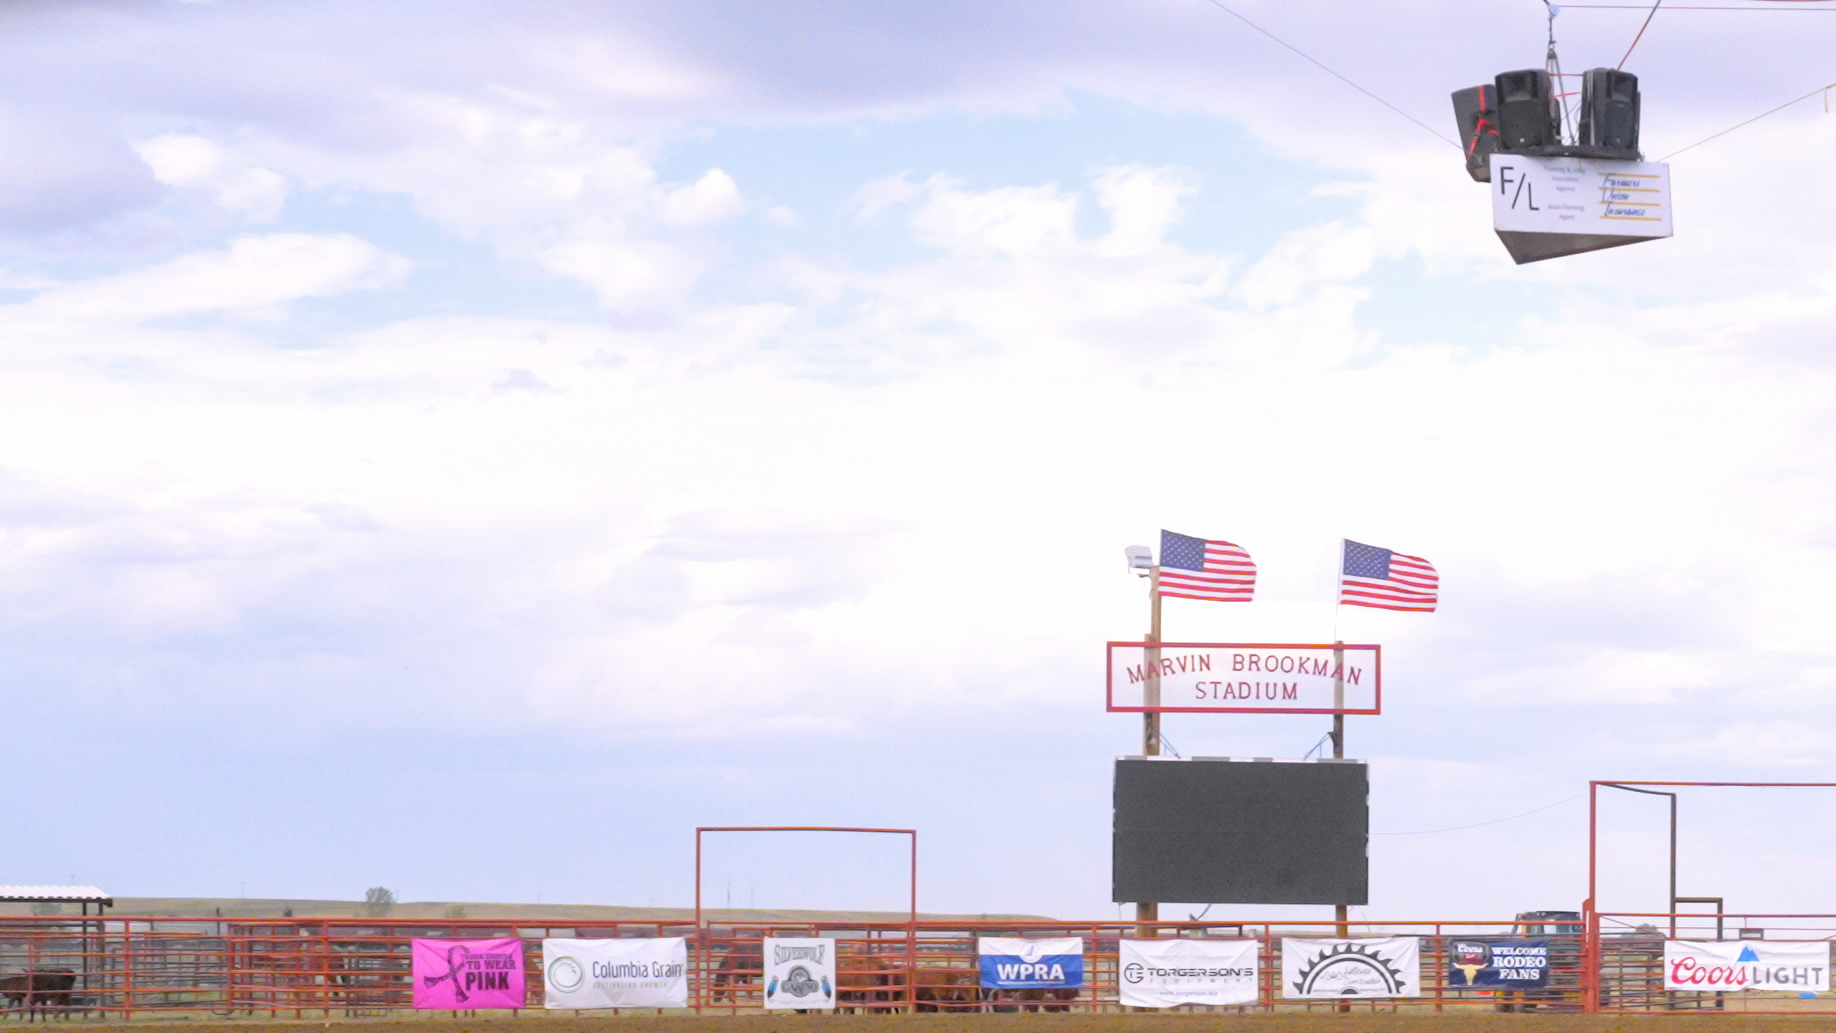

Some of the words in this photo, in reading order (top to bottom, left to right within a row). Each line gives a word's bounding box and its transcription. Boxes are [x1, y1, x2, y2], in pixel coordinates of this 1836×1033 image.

[1500, 166, 1540, 211] F/L
[1126, 654, 1211, 684] MARVIN
[1232, 654, 1362, 686] BROOKMAN
[1195, 681, 1298, 700] STADIUM
[1491, 947, 1547, 955] WELCOME
[466, 961, 480, 970] TO
[484, 960, 516, 969] WEAR
[592, 961, 648, 979] Columbia
[652, 960, 682, 978] Grain
[1492, 956, 1546, 968] RODEO
[1670, 956, 1749, 985] Coors
[1753, 966, 1824, 985] LIGHT
[997, 963, 1065, 980] WPRA
[1147, 967, 1254, 977] TORGERSON'S
[1498, 969, 1540, 980] FANS
[465, 971, 509, 991] PINK
